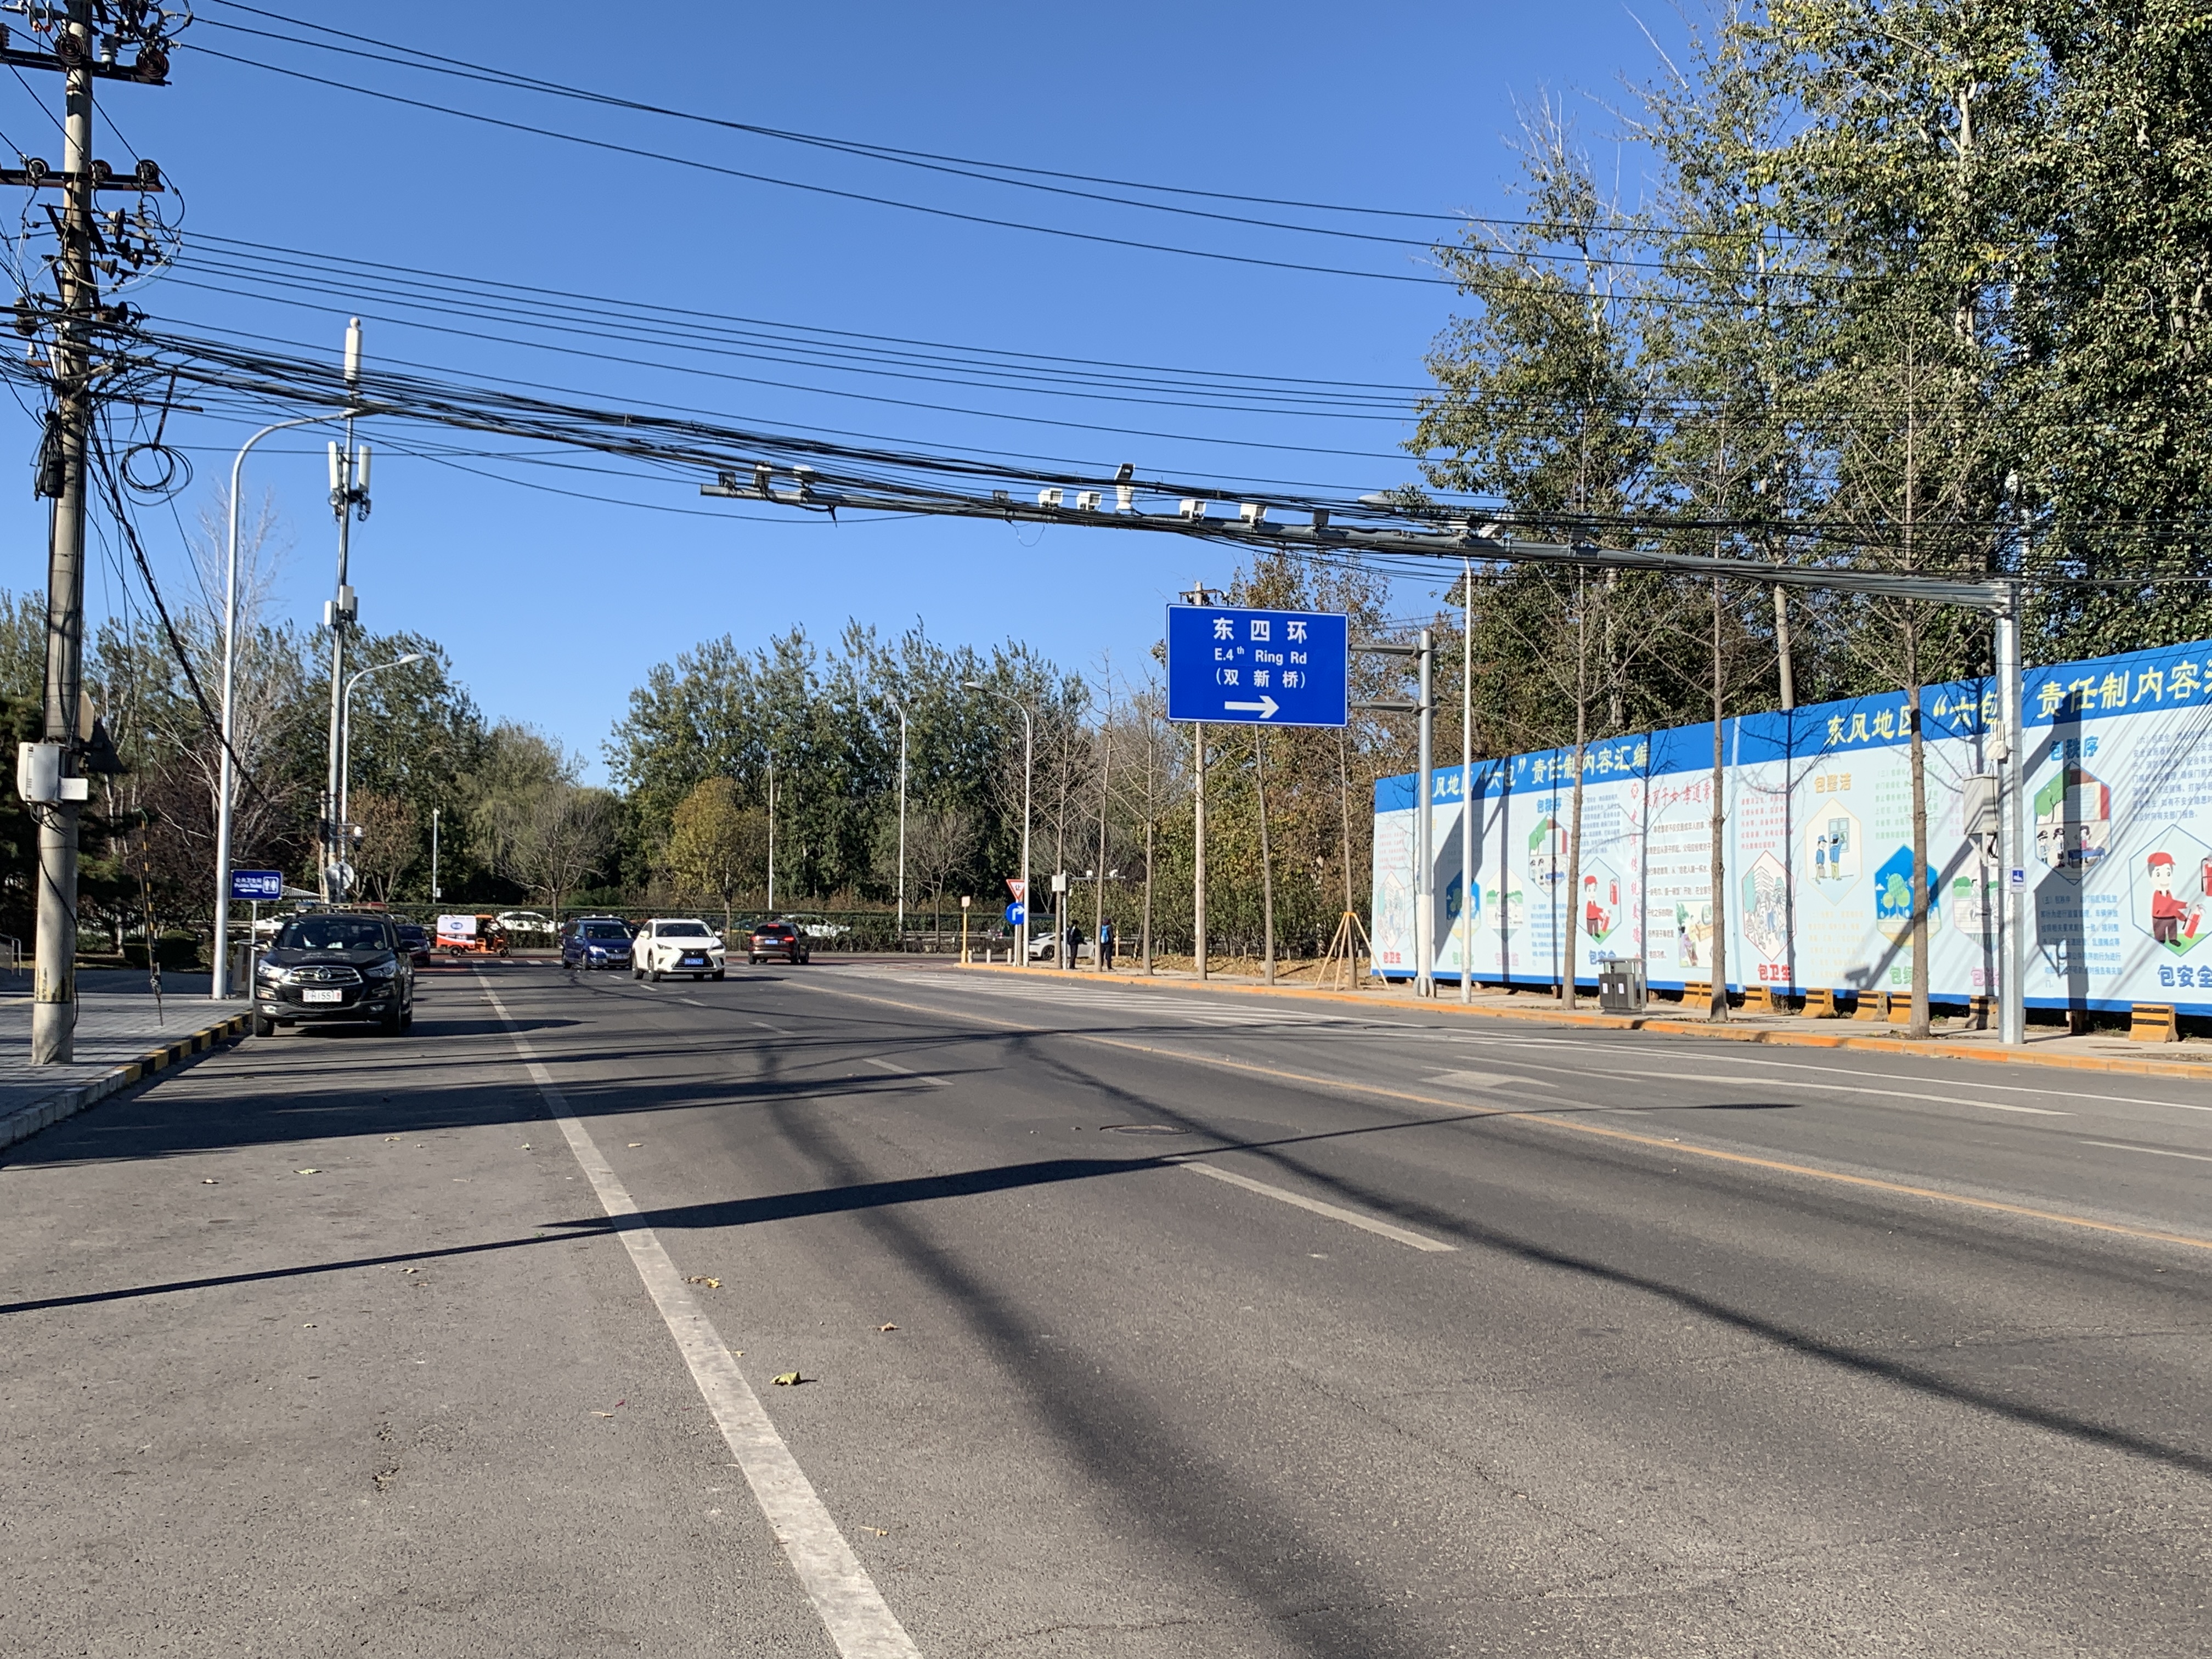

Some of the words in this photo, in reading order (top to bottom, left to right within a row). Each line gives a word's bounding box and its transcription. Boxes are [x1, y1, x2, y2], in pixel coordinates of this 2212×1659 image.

[1213, 617, 1308, 644] 东四环
[1255, 650, 1283, 665] Ring
[1290, 651, 1307, 664] Rd
[2049, 736, 2098, 761] 包秩序
[1644, 779, 1714, 809] 教育子女孝道常
[1814, 772, 1852, 793] 包整洁
[1758, 963, 1792, 981] 包卫生
[2157, 964, 2212, 988] 包安全
